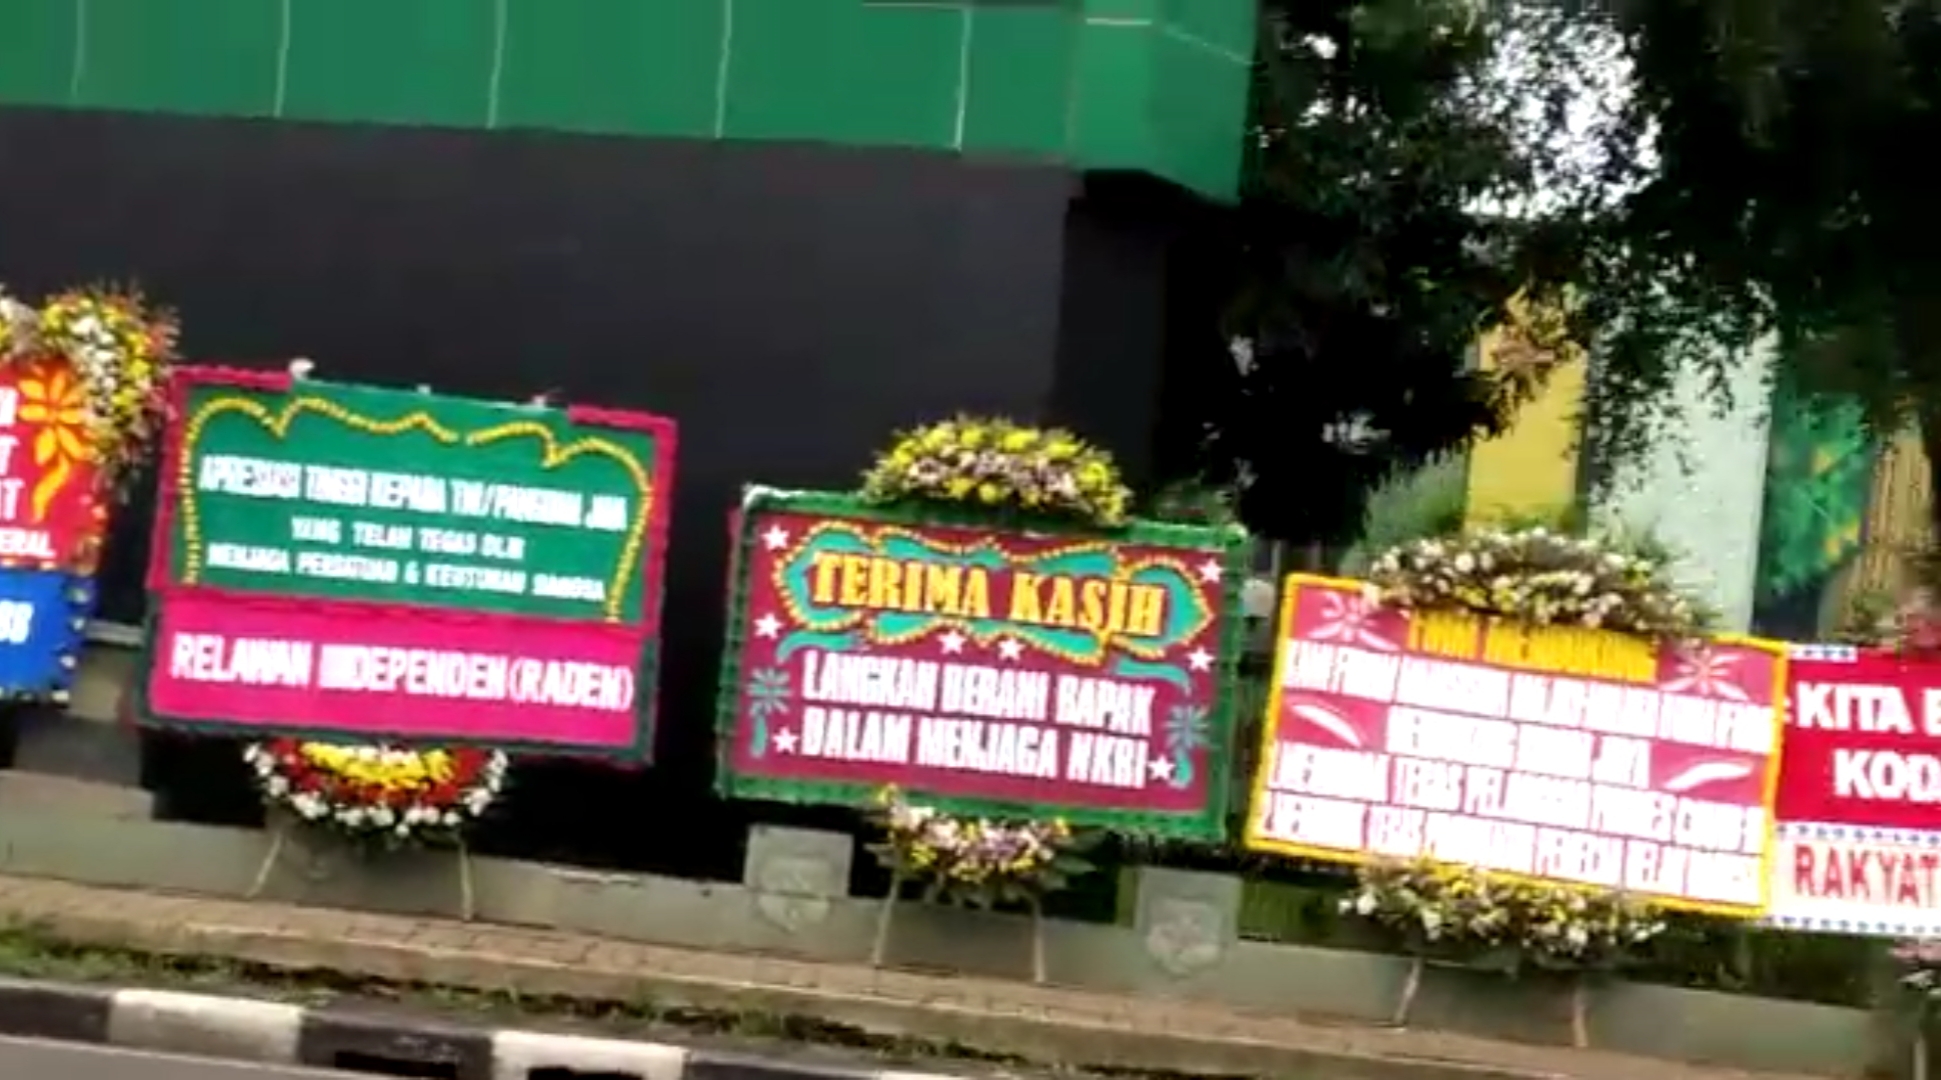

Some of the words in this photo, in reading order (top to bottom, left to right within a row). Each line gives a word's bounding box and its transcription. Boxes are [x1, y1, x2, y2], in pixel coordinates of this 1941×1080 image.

[811, 553, 991, 619] TERIMA
[1008, 570, 1168, 637] KASIH
[170, 631, 312, 687] RELAWAN
[319, 643, 508, 700] INDEPENDEN
[1056, 673, 1156, 737] BAPAK
[1796, 680, 1915, 734] KITA
[801, 706, 912, 764] DALAM
[915, 716, 1059, 779] MENJAGA
[1066, 730, 1149, 789] NKRI
[1833, 748, 1941, 803] KOD
[1794, 843, 1940, 910] RAKYAT
